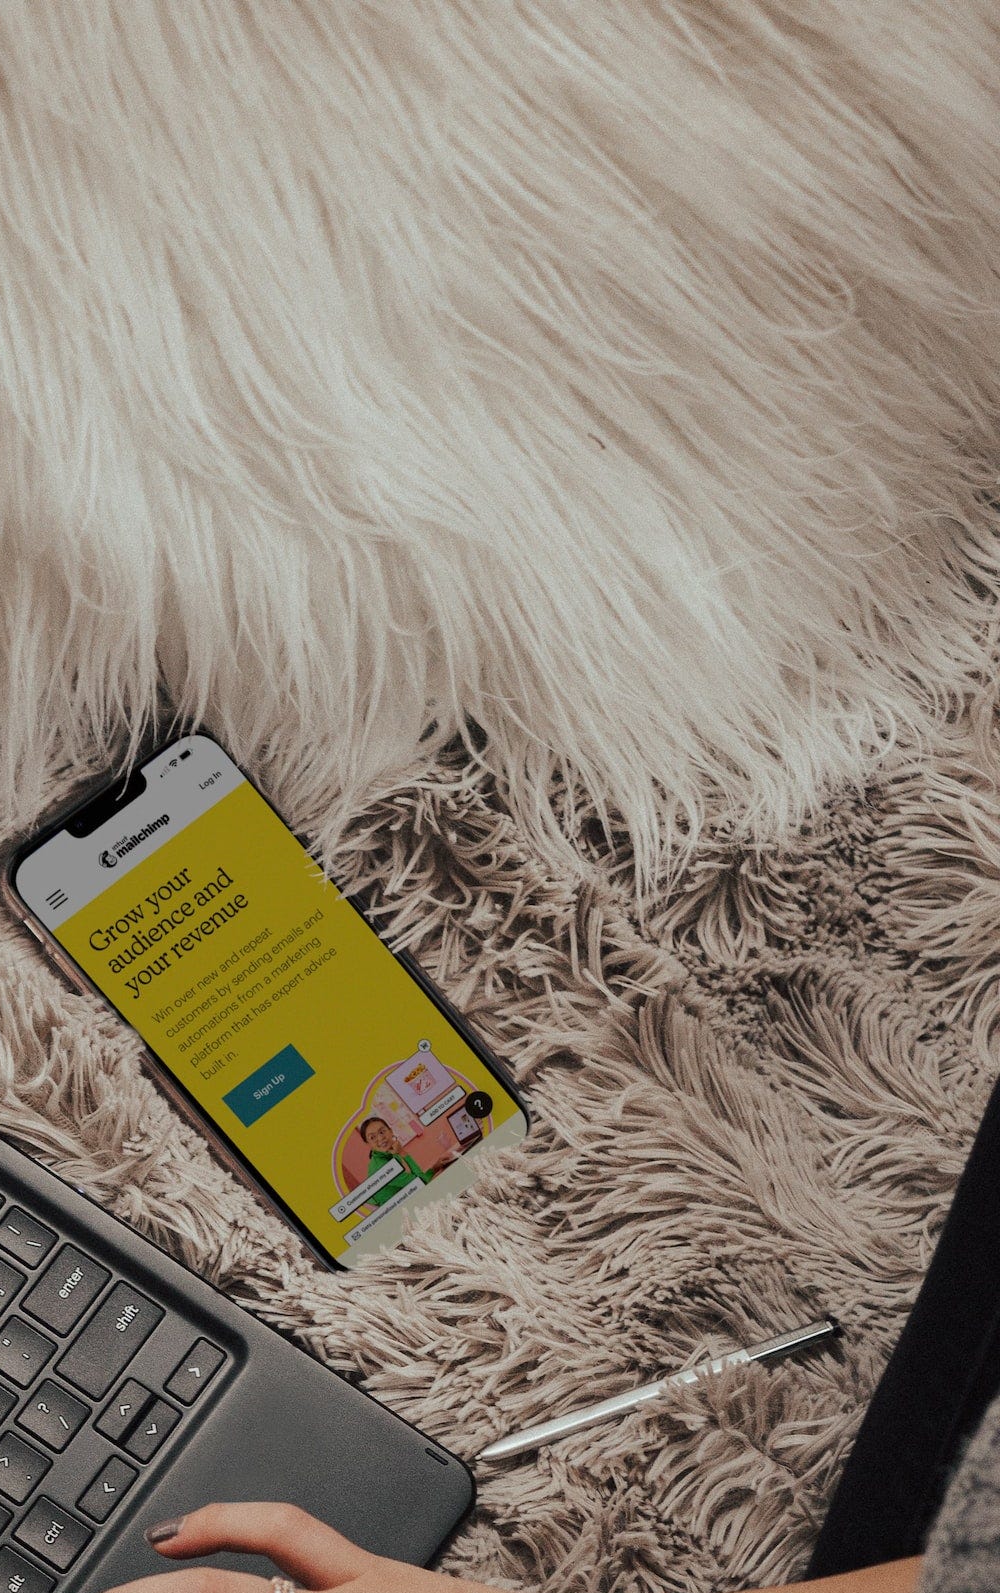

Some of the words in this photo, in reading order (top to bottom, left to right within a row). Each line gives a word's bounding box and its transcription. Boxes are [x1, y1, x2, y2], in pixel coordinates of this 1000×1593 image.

[198, 777, 215, 790] Log
[210, 771, 222, 783] In
[111, 836, 128, 851] intuit
[116, 814, 170, 858] mailchimp
[89, 903, 145, 951] Grow
[144, 868, 192, 915] your
[108, 902, 195, 974] audience
[193, 867, 234, 907] and
[124, 952, 172, 1000] your
[170, 894, 249, 959] revenue
[151, 1006, 175, 1024] Win
[174, 986, 197, 1008] over
[196, 969, 219, 991] new
[219, 951, 241, 973] and
[238, 927, 273, 957] repeat
[165, 994, 219, 1038] customers
[215, 983, 232, 998] by
[231, 952, 273, 986] sending
[271, 926, 305, 955] emails
[303, 908, 324, 930] and
[177, 1001, 240, 1053] automations
[236, 982, 264, 1004] from
[263, 976, 272, 985] a
[270, 937, 322, 978] marketing
[189, 1030, 233, 1069] platform
[230, 1013, 254, 1033] that
[250, 999, 272, 1017] has
[271, 973, 305, 1002] expert
[303, 947, 338, 977] advice
[199, 1059, 226, 1081] built
[224, 1051, 239, 1063] in.
[253, 1083, 274, 1100] Sign
[270, 1073, 286, 1085] Up
[429, 1108, 439, 1118] ADD
[437, 1101, 448, 1110] TO
[444, 1095, 455, 1106] CART
[473, 1099, 484, 1111] ?
[346, 1188, 367, 1207] Customer
[58, 1265, 84, 1300] enter
[116, 1305, 140, 1333] shift
[37, 1403, 51, 1415] ?
[44, 1521, 66, 1545] ctrl
[8, 1573, 27, 1593] alt
